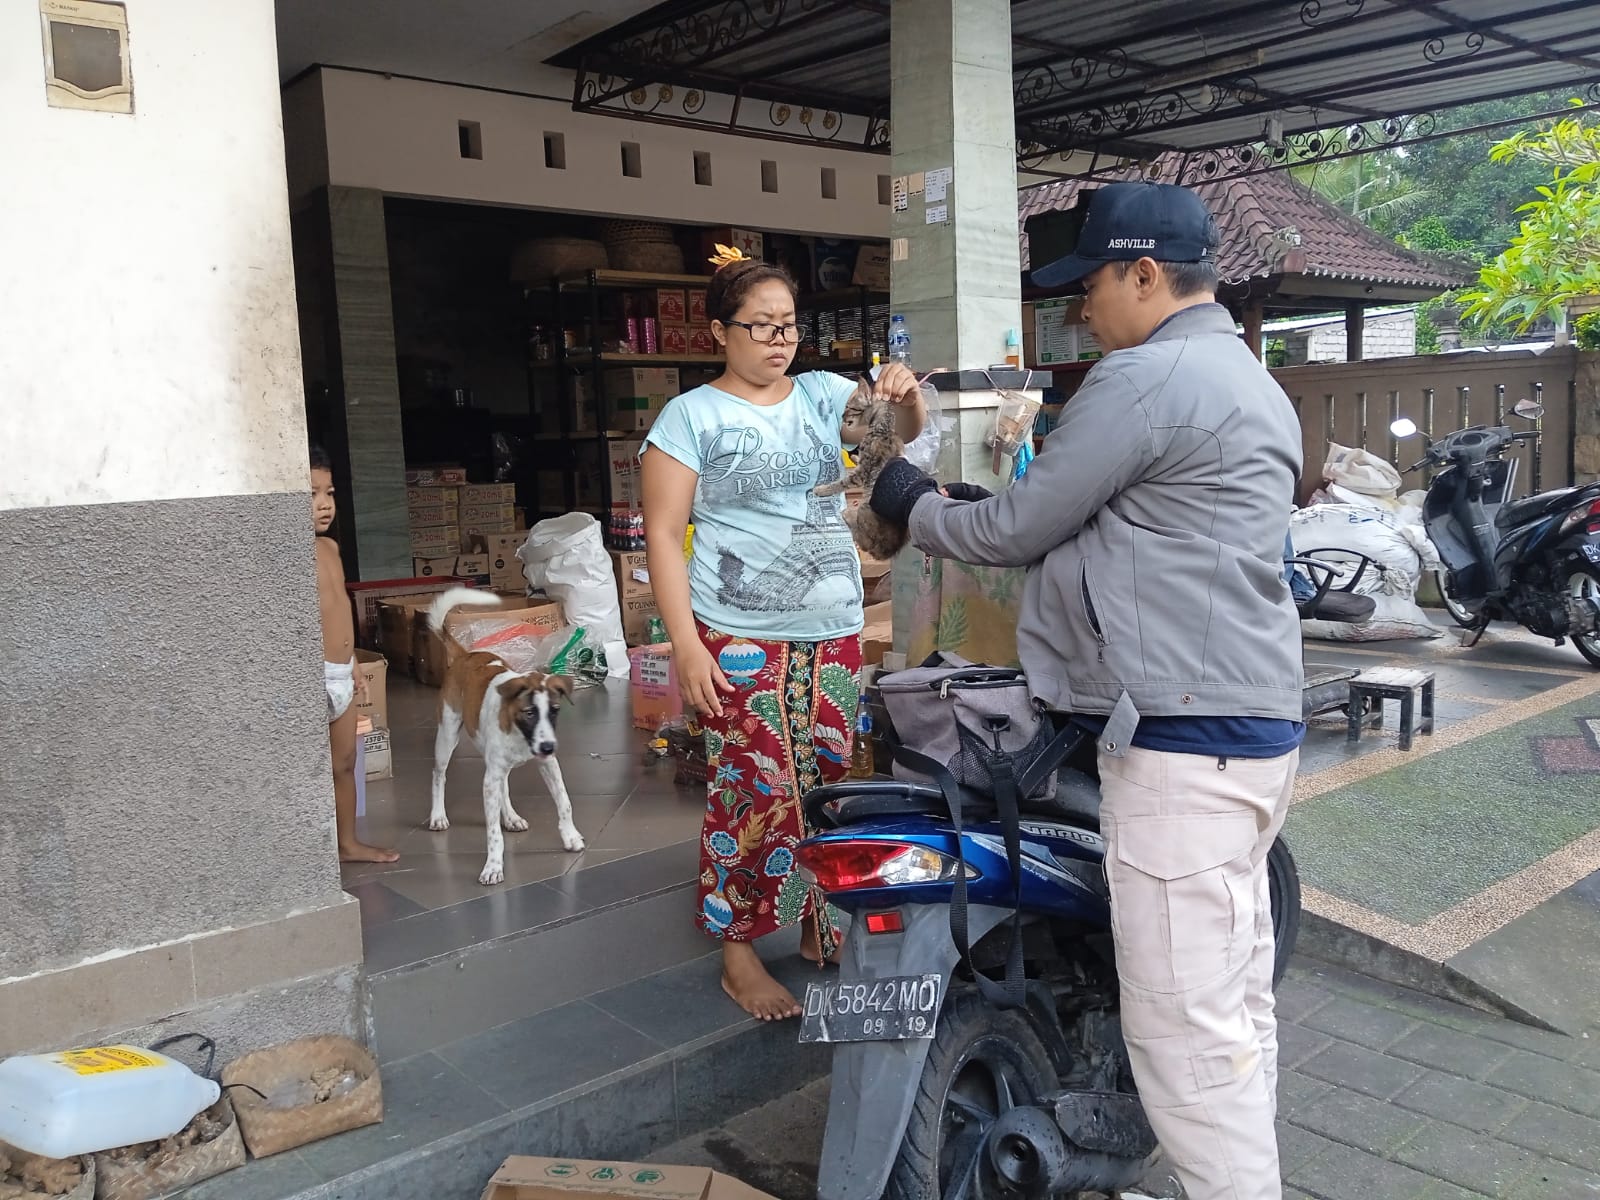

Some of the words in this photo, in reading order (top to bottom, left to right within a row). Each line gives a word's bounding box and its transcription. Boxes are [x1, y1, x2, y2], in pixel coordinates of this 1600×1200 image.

[1107, 238, 1156, 249] ASHVILLE
[735, 467, 811, 495] PARIS
[807, 983, 835, 1017] DK
[836, 982, 897, 1015] 5842
[863, 1018, 884, 1035] 09
[907, 1015, 928, 1033] 19
